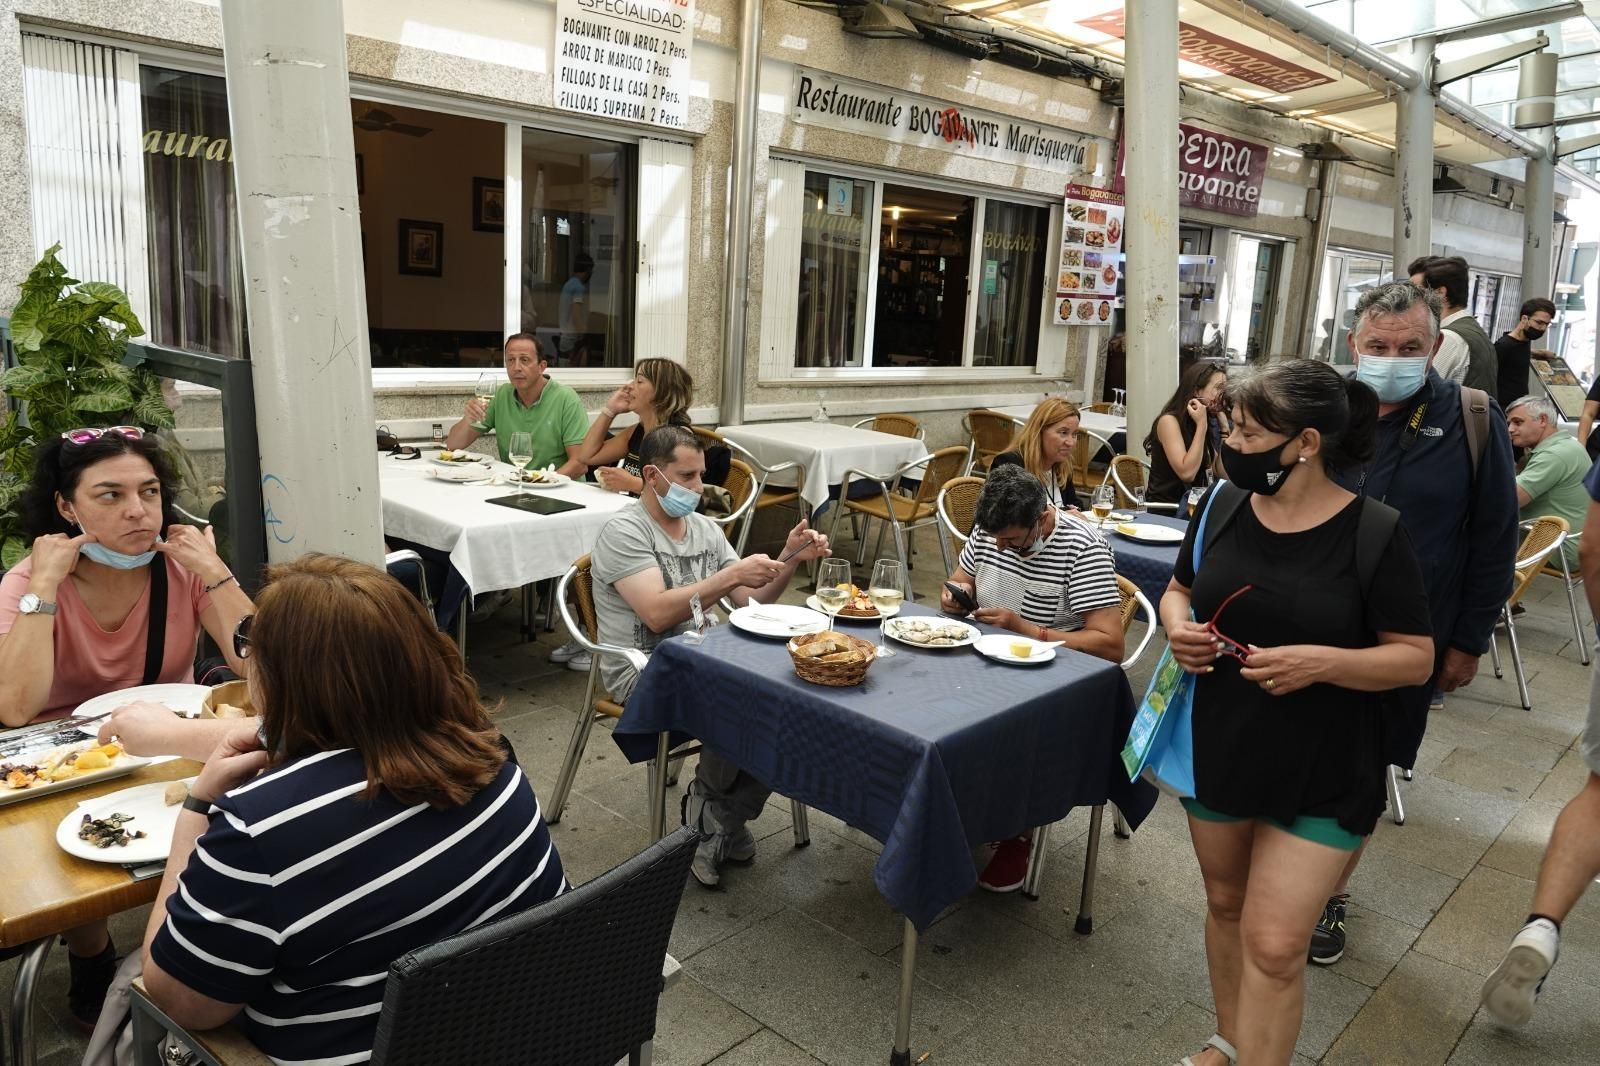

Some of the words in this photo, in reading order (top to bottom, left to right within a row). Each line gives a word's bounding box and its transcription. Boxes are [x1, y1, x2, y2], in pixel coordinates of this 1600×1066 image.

[563, 17, 612, 42] BOGAVANTE
[614, 29, 630, 46] CON
[633, 34, 659, 53] ARROZ
[662, 40, 667, 55] 2
[669, 42, 687, 59] Pers.
[562, 41, 592, 61] ARROZ
[594, 48, 605, 64] DE
[607, 51, 643, 72] MARISCO
[646, 59, 651, 74] 2
[653, 61, 672, 78] Pers.
[561, 66, 596, 88] FILLOAS
[599, 74, 611, 91] DE
[613, 77, 623, 93] LA
[628, 80, 648, 98] CASA
[652, 84, 658, 99] 2
[660, 86, 680, 104] Pers.
[560, 91, 599, 112] FILLOAS
[603, 99, 645, 120] SUPREMA
[650, 107, 656, 122] 2
[660, 109, 682, 127] Pers.
[796, 76, 903, 128] Restaurante
[908, 104, 999, 148] BOGAVANTE
[1005, 123, 1086, 165] Marisquería
[1179, 189, 1257, 213] STAURANTE
